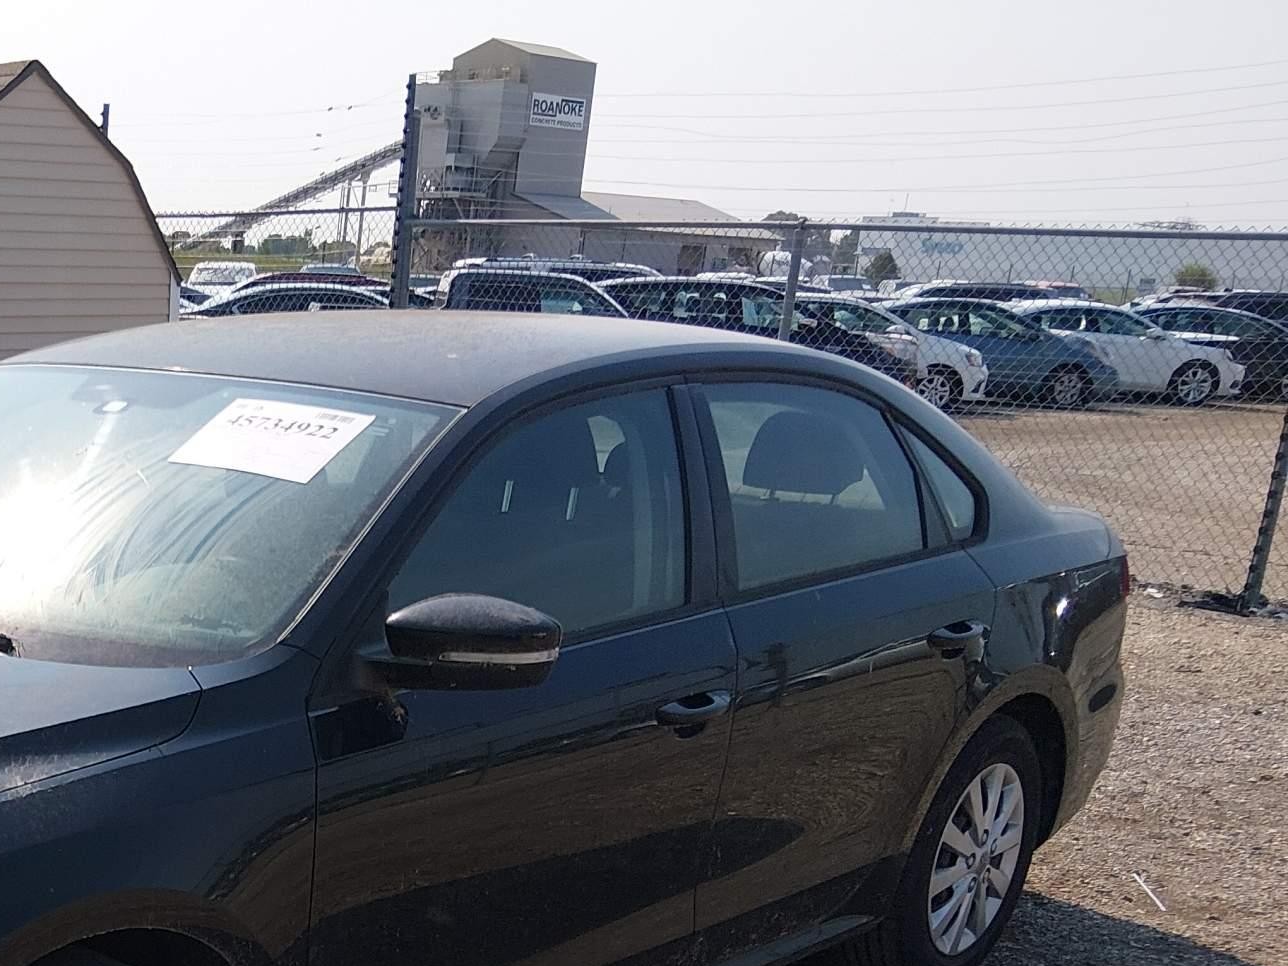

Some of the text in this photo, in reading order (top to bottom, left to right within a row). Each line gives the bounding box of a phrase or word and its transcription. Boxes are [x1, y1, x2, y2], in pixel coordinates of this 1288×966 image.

[532, 98, 585, 118] ROANOKE
[531, 116, 582, 129] CONCRETE PRODUCTS
[227, 414, 339, 440] 45734922
